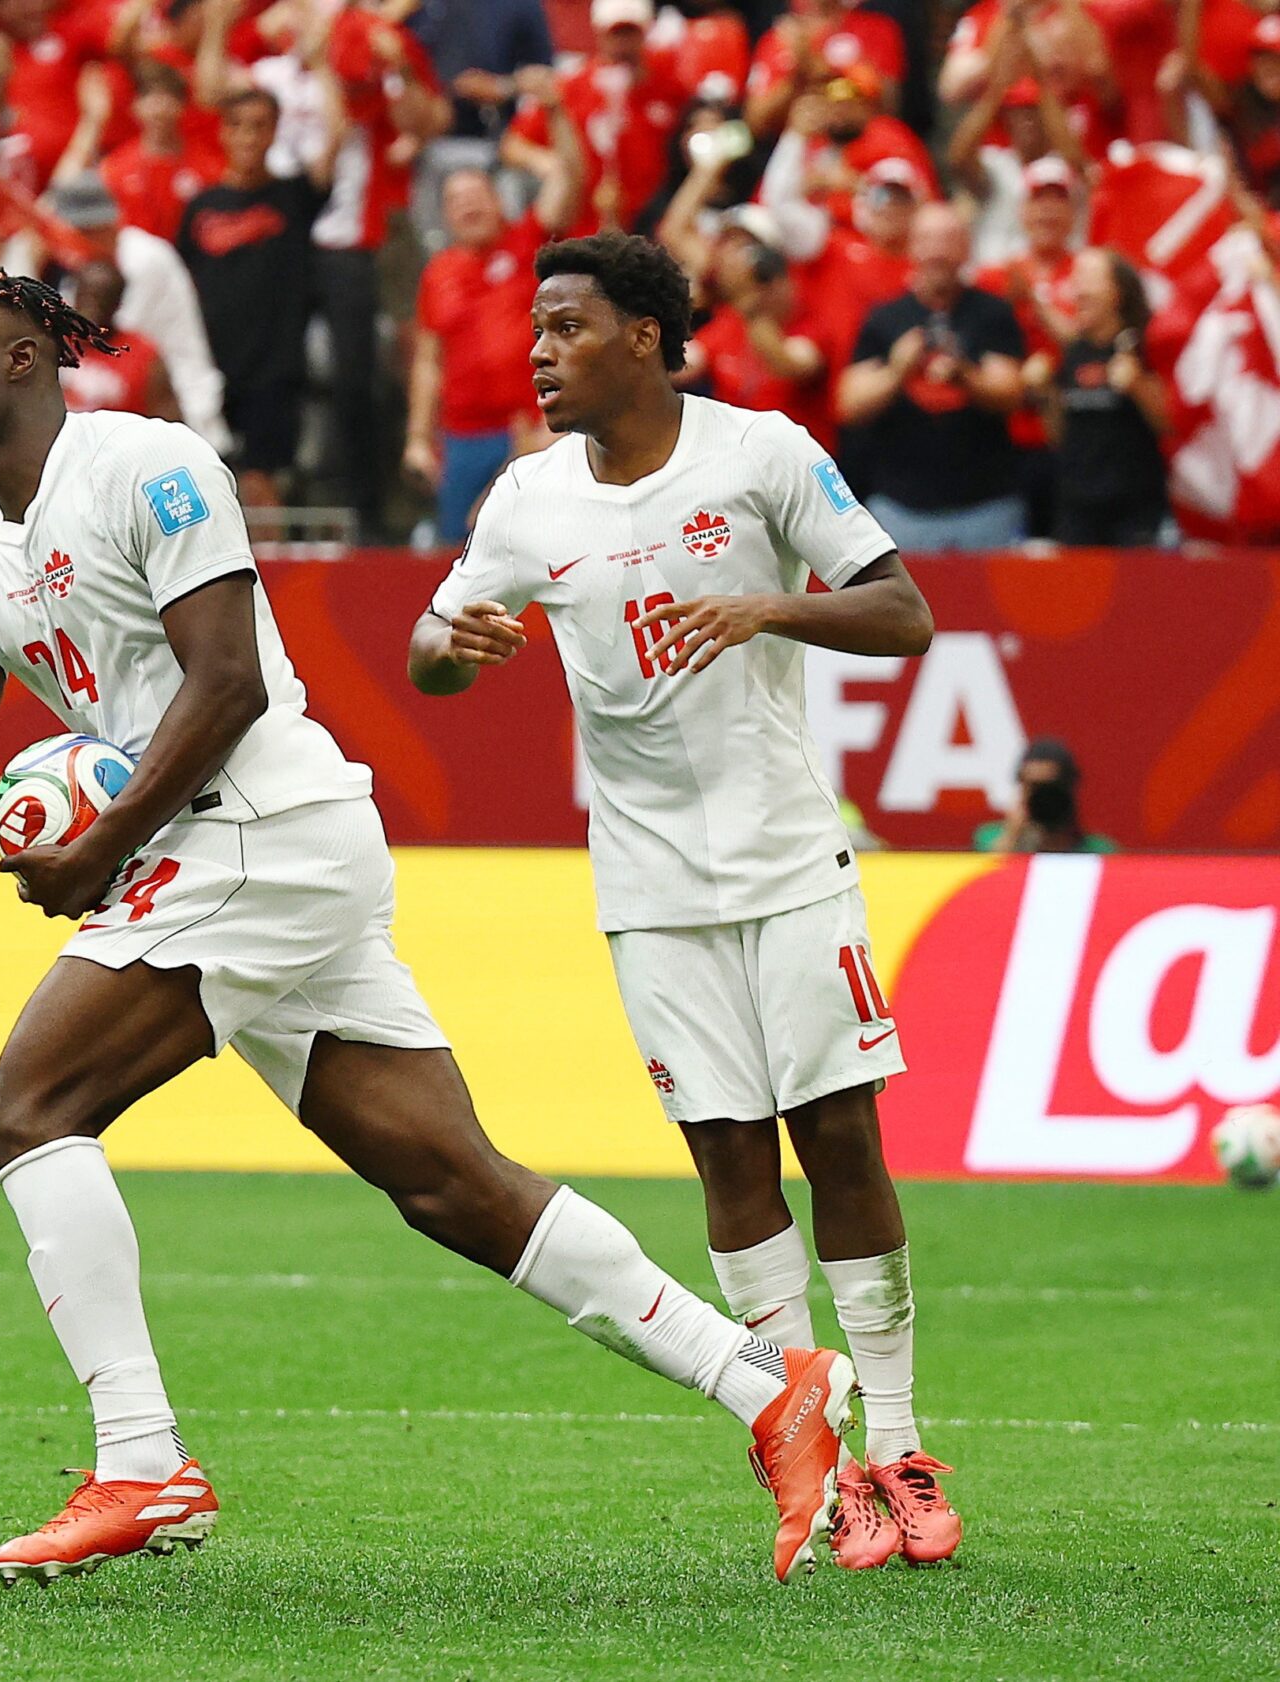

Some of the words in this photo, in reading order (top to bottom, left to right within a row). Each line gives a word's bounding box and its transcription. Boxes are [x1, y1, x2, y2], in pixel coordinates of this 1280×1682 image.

[682, 526, 730, 544] CANADA
[45, 564, 74, 583] CANADA
[784, 1384, 821, 1443] NEMESIS
